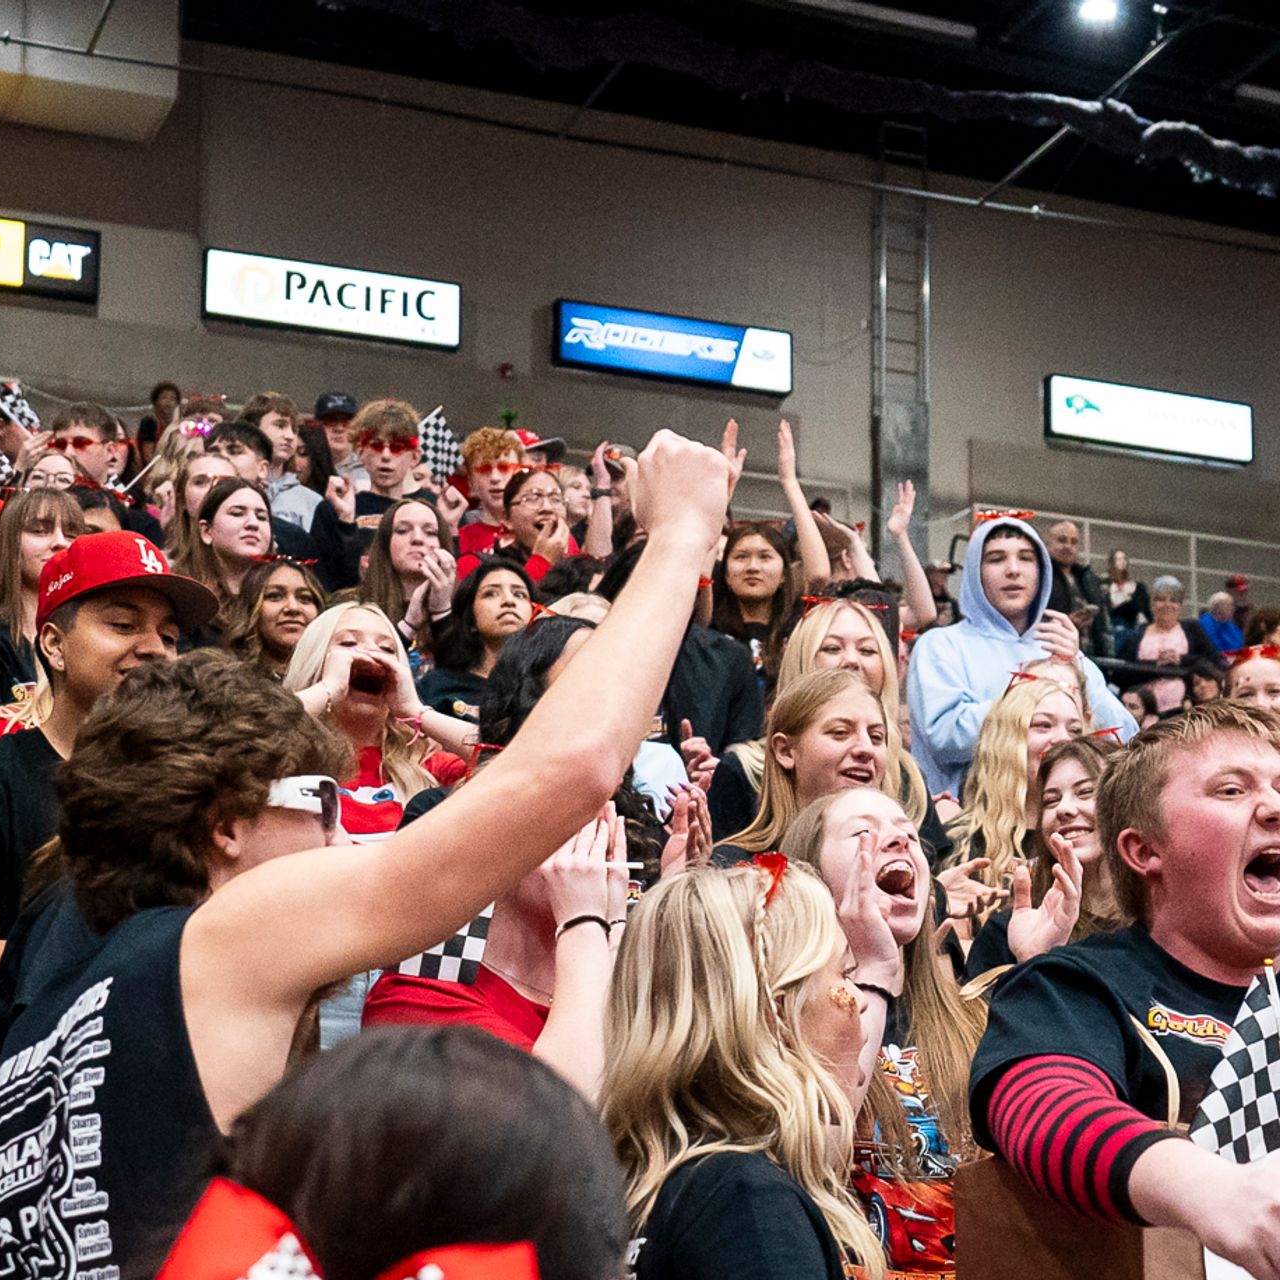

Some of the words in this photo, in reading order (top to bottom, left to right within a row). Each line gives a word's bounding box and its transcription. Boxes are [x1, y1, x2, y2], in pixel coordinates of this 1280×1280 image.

[28, 239, 91, 281] CAT
[284, 270, 436, 321] PACIFIC
[134, 537, 163, 574] LA
